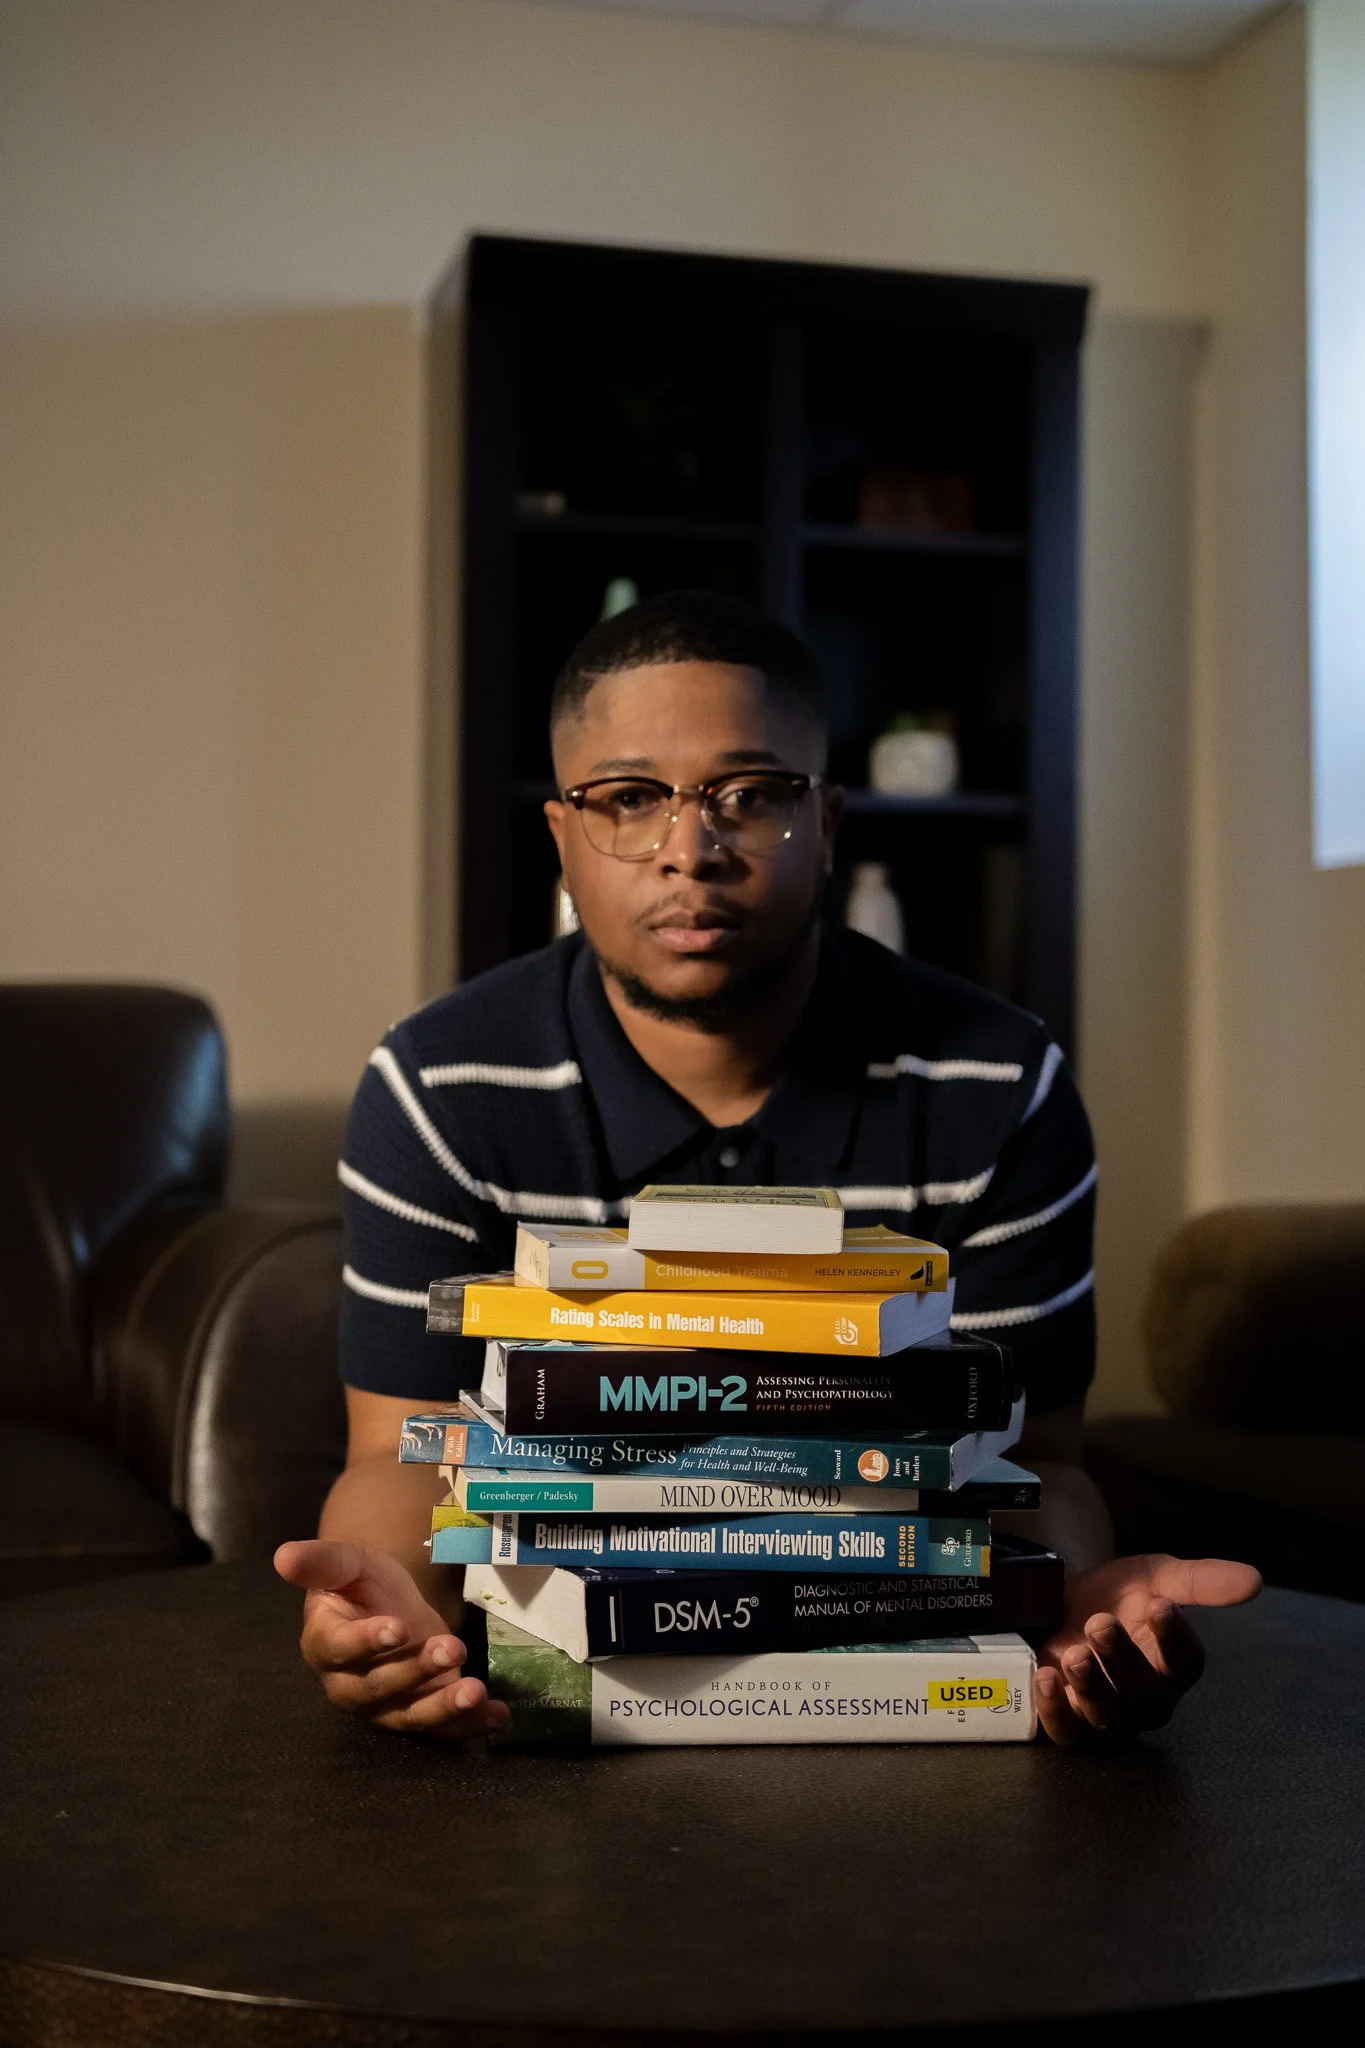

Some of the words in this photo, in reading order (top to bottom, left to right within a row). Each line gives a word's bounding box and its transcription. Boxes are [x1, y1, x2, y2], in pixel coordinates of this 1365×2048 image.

[655, 1264, 730, 1277] Childhood
[736, 1265, 787, 1278] Trauma
[815, 1268, 845, 1277] HELEN
[848, 1268, 901, 1277] KENNERLEY
[550, 1307, 594, 1328] Rating
[598, 1309, 644, 1328] Scales
[649, 1312, 662, 1330] in
[667, 1313, 714, 1333] Mental
[719, 1316, 764, 1335] Health
[756, 1375, 815, 1386] ASSESSING
[535, 1369, 546, 1420] GRAHAM
[600, 1375, 748, 1412] MMPI-2
[756, 1389, 781, 1399] AND
[785, 1389, 895, 1399] PSYCHOPATHOLOGY
[967, 1366, 979, 1419] OXFORD
[447, 1436, 455, 1453] Fifth
[456, 1432, 464, 1457] Edition
[490, 1433, 604, 1467] Managing
[612, 1440, 677, 1464] Stress
[683, 1443, 728, 1457] Principles
[730, 1446, 748, 1457] and
[751, 1446, 796, 1461] Strategies
[679, 1458, 695, 1471] for
[697, 1458, 730, 1470] Health
[732, 1460, 751, 1472] and
[754, 1462, 808, 1477] Well-Being
[834, 1449, 842, 1480] Seaward
[893, 1458, 901, 1477] Jones
[480, 1491, 534, 1502] Greenberger
[543, 1491, 579, 1502] Padesky
[659, 1485, 716, 1508] MIND
[721, 1485, 774, 1508] OVER
[779, 1485, 842, 1508] MOOD
[499, 1513, 513, 1558] Rosengren
[535, 1522, 604, 1555] Building
[610, 1524, 716, 1554] Motivational
[722, 1527, 832, 1561] Interviewing
[838, 1530, 885, 1558] Skills
[898, 1525, 906, 1568] SECOND
[908, 1525, 916, 1568] EDITION
[964, 1529, 972, 1567] GUILFORD
[794, 1581, 875, 1599] DIAGNOSTIC
[878, 1579, 908, 1595] AND
[911, 1576, 980, 1593] STATISTICAL
[794, 1601, 851, 1618] MANUAL
[854, 1600, 872, 1615] OF
[875, 1598, 924, 1614] MENTAL
[927, 1594, 993, 1611] DISORDERS
[710, 1681, 803, 1691] HANDBOOK
[812, 1681, 832, 1691] OF
[940, 1685, 994, 1702] USED
[610, 1699, 792, 1717] PSYCHOLOGICAL
[799, 1698, 928, 1716] ASSESSMENT
[1014, 1688, 1022, 1713] WILEY
